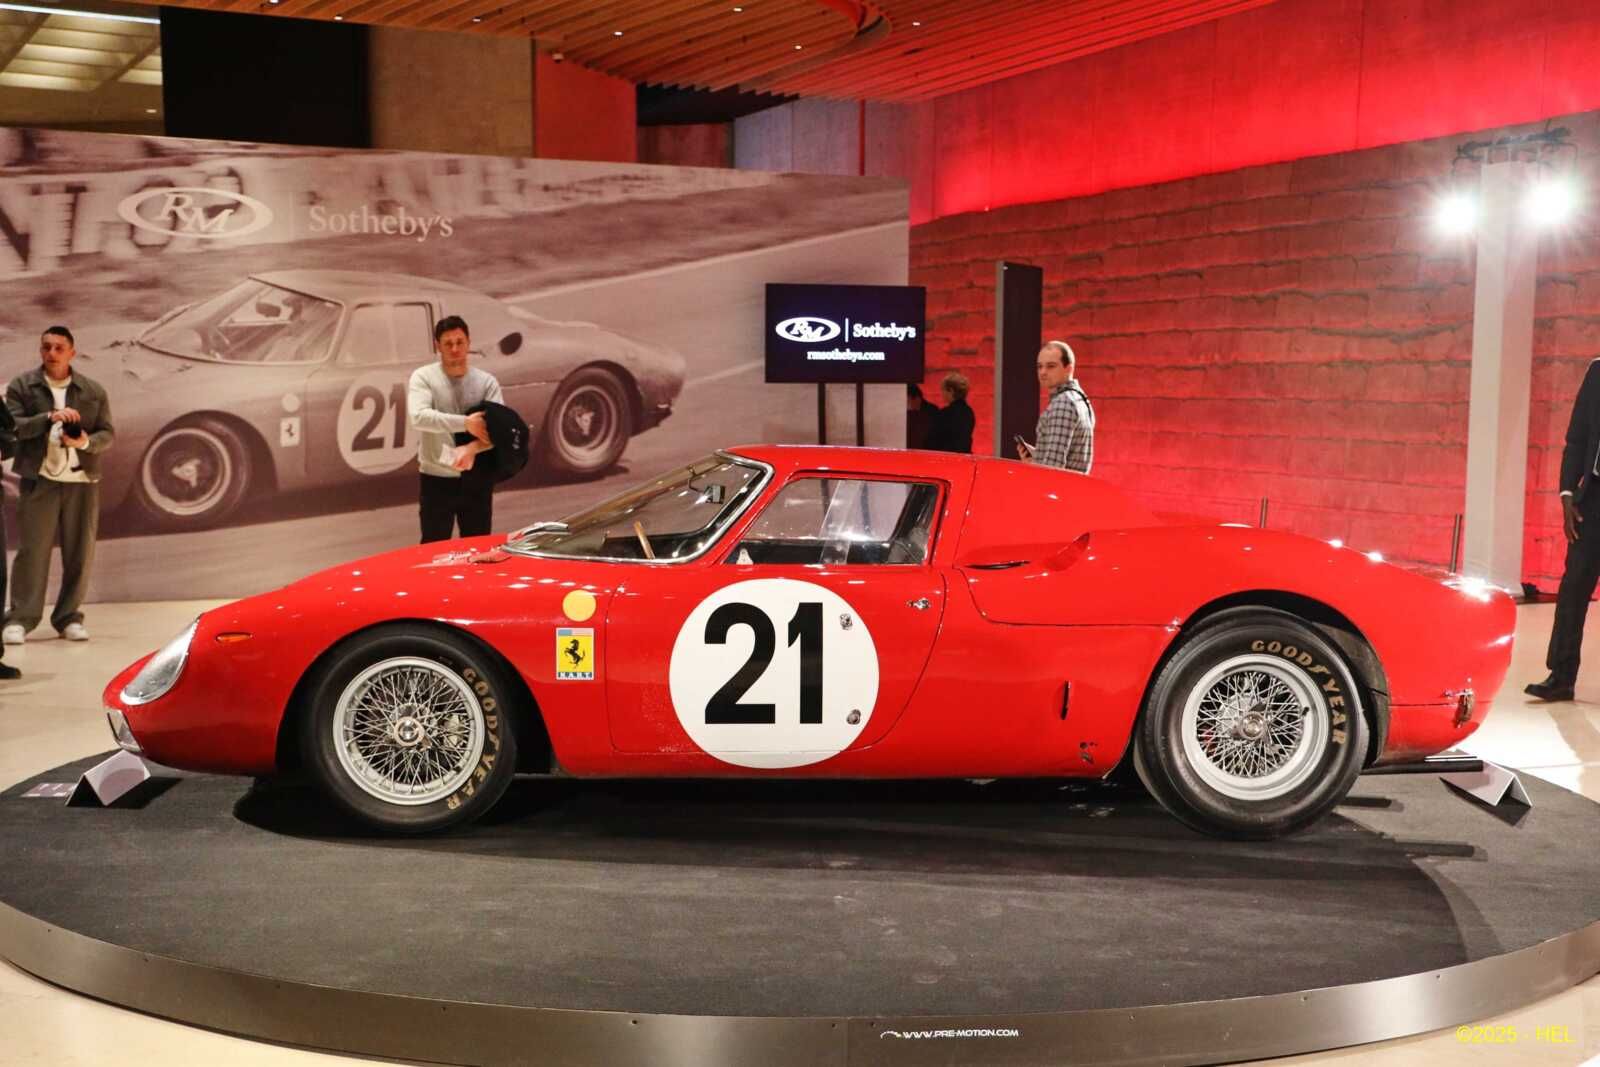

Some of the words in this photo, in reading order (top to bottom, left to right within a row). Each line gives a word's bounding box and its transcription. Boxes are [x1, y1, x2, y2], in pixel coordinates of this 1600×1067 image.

[308, 205, 454, 242] Sotheby's
[806, 348, 886, 363] rmsothebys.com
[852, 322, 916, 341] Sotheby's
[351, 383, 407, 453] 21
[704, 602, 823, 724] 21
[1251, 639, 1347, 745] GOODYEAR
[447, 667, 500, 811] GOODYEAR
[902, 1028, 1020, 1039] WWW.PRE-MOTION.COM
